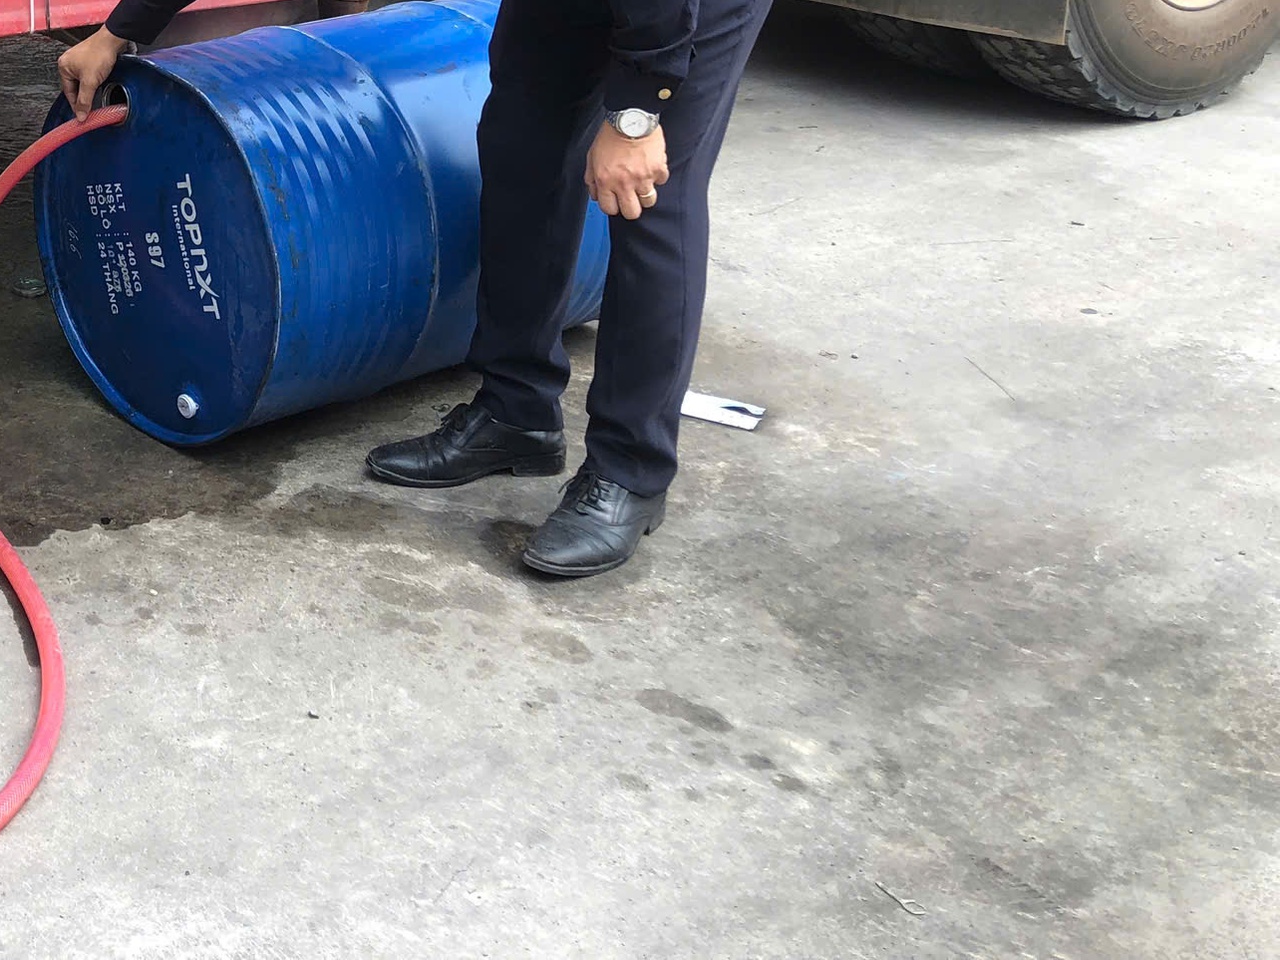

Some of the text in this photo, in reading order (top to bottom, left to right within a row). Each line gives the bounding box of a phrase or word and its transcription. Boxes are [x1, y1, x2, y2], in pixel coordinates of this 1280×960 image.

[86, 185, 98, 216] HSD
[97, 242, 107, 259] 24
[104, 183, 116, 213] NSX
[114, 183, 126, 212] KLT
[125, 242, 136, 266] 140
[131, 270, 142, 293] KG
